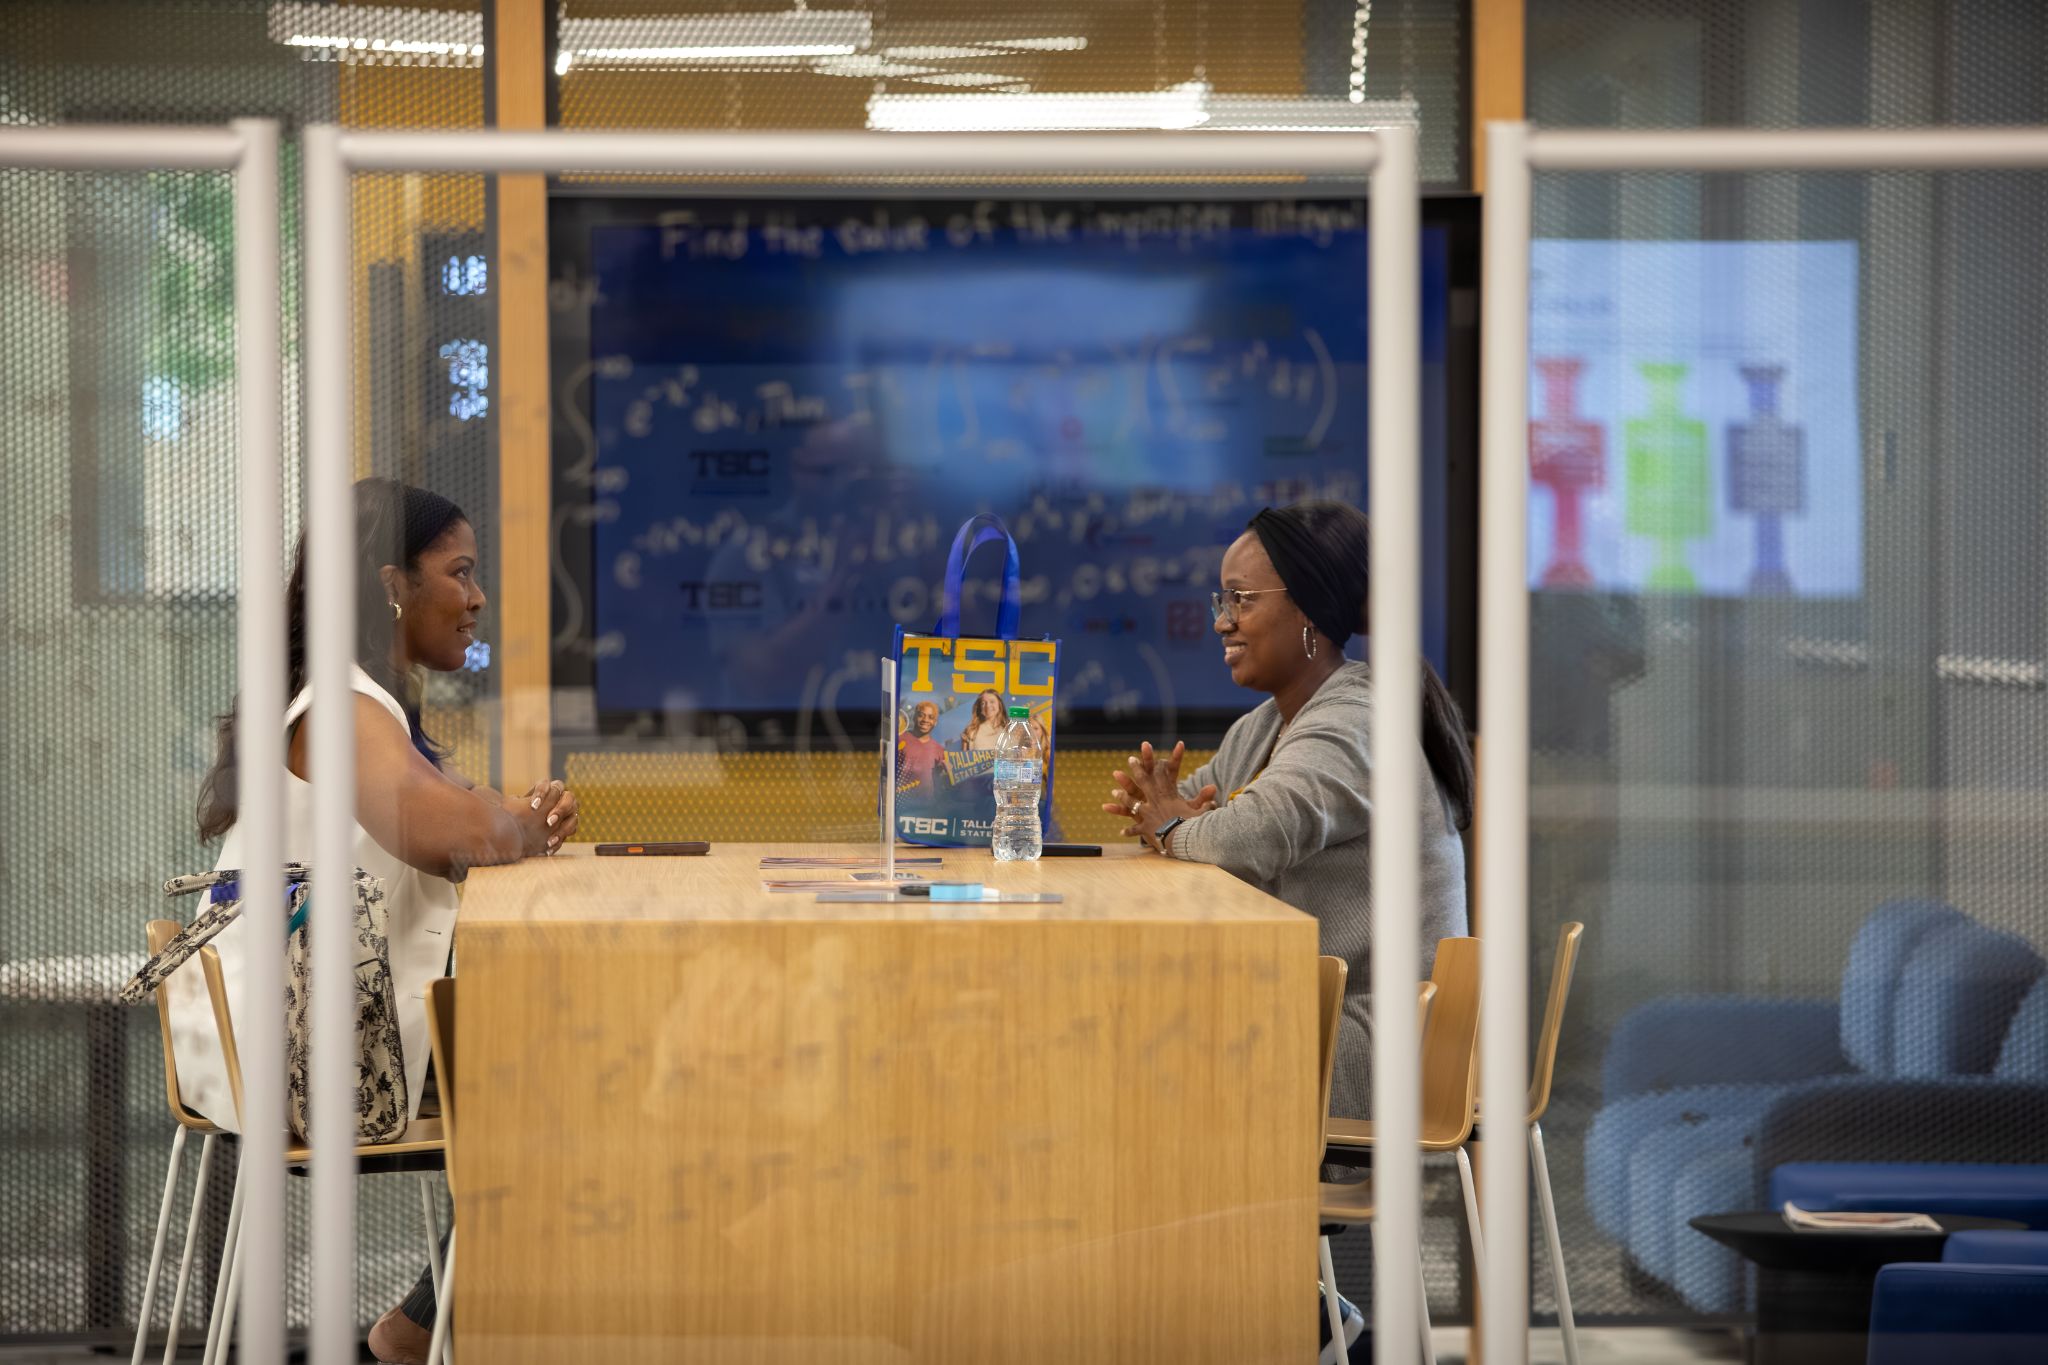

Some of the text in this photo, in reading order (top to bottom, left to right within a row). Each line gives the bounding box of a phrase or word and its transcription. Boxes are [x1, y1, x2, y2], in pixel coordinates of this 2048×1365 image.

[902, 636, 1056, 696] TSC
[900, 816, 948, 835] TSC
[961, 819, 994, 829] TALLA
